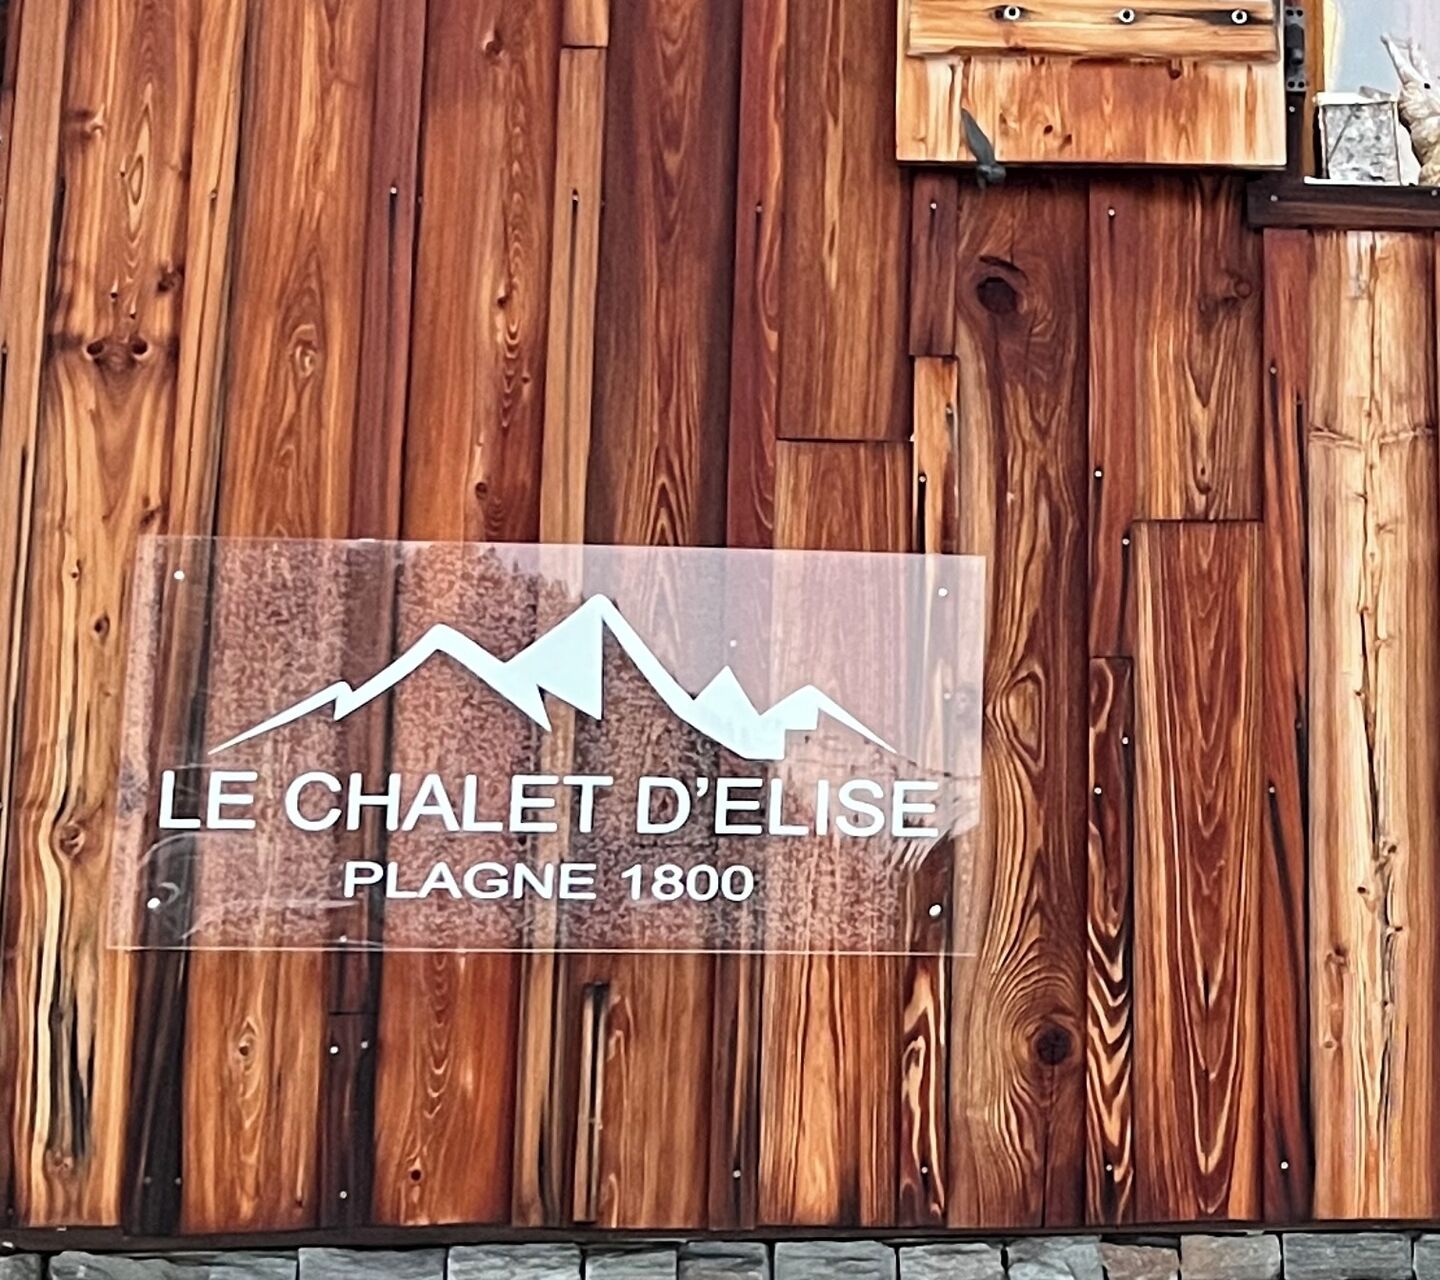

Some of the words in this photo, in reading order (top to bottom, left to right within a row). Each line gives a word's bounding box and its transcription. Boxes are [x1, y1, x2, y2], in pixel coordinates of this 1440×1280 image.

[158, 768, 257, 830] LE
[285, 769, 613, 834] CHALET
[342, 860, 597, 901] PLAGNE
[620, 863, 755, 903] 1800
